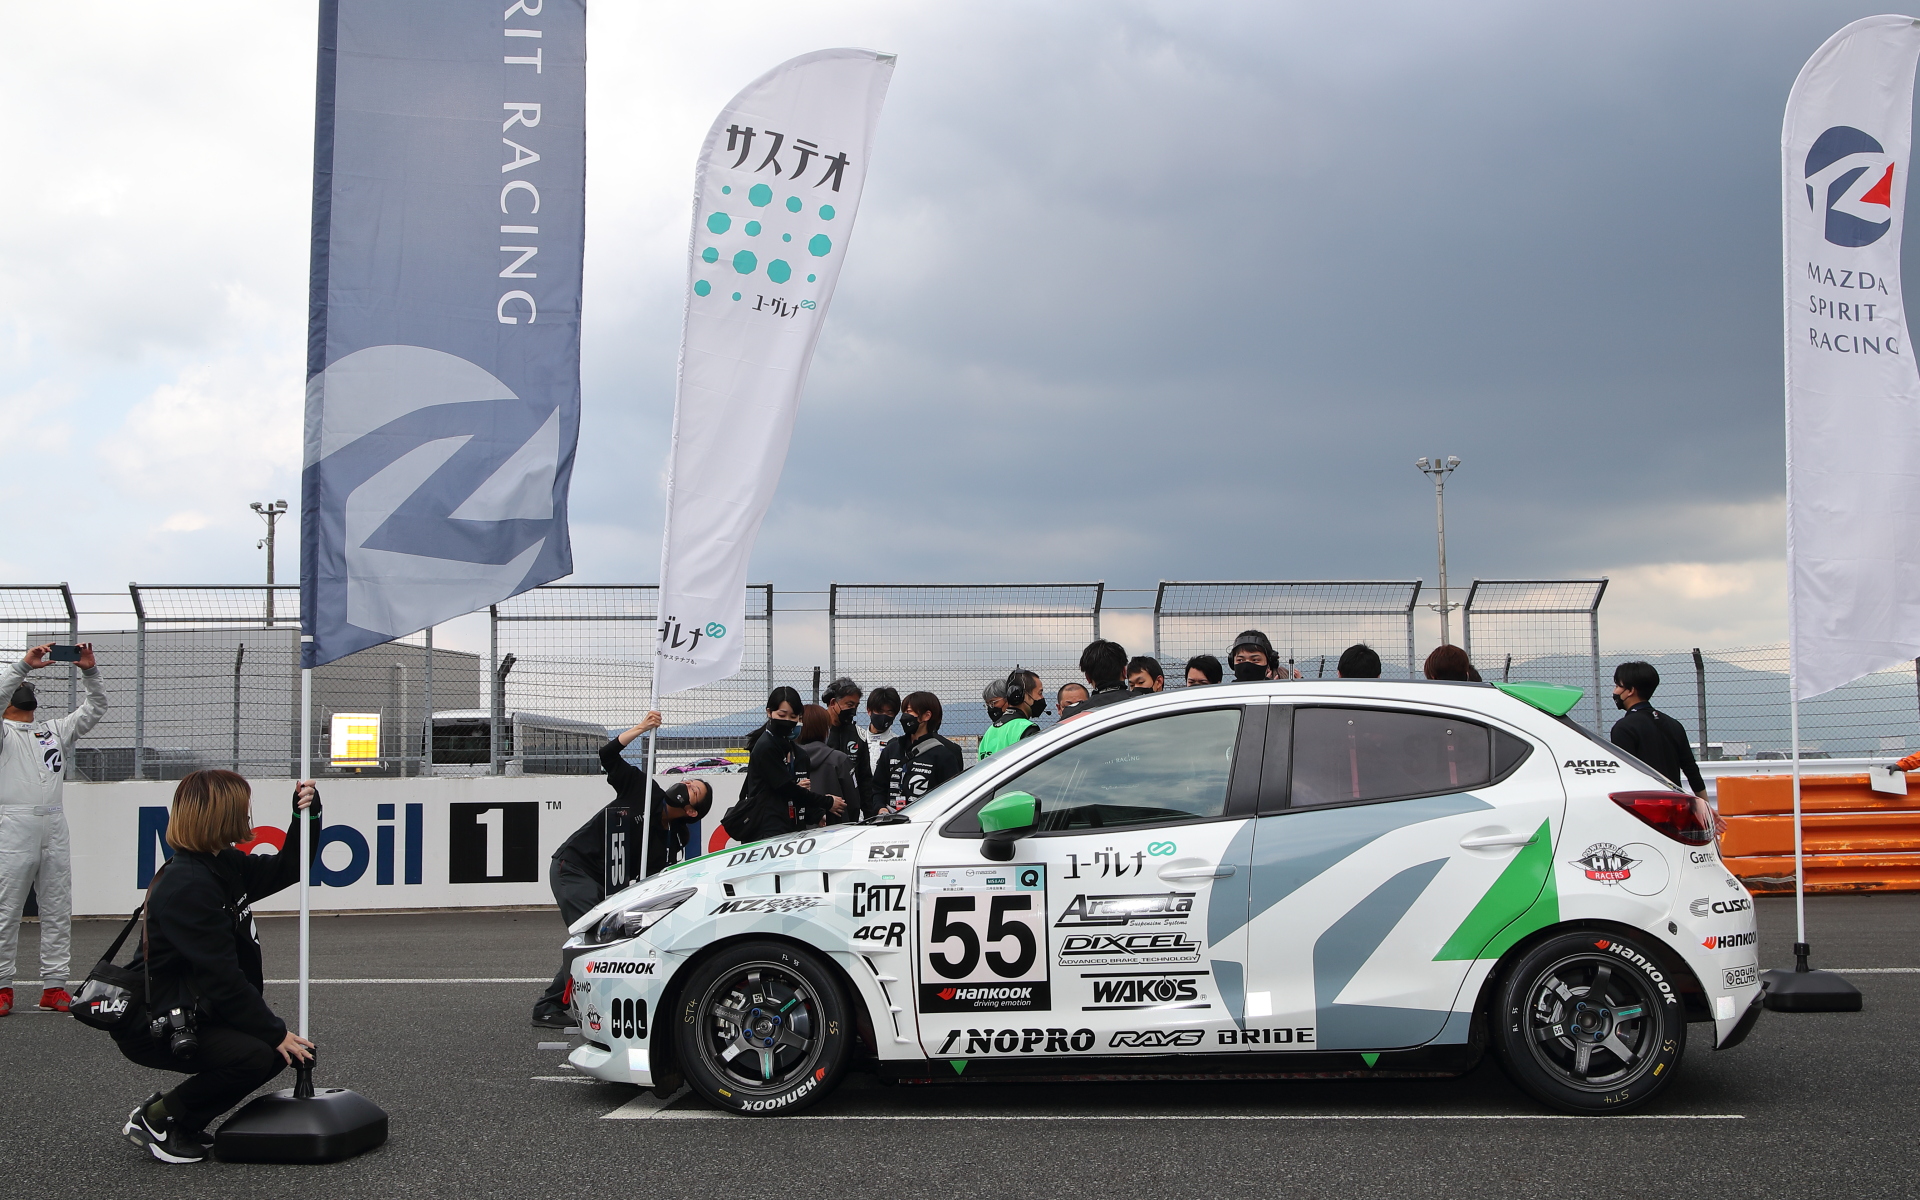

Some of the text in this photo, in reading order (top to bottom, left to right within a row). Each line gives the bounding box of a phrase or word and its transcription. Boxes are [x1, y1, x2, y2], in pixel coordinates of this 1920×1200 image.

[725, 124, 850, 192] サステオ
[497, 102, 541, 325] RACING
[1808, 262, 1888, 295] MAZDA
[752, 294, 799, 319] ユーグレナ
[1809, 295, 1877, 322] SPIRIT
[1810, 327, 1899, 354] RACING
[1564, 760, 1620, 768] AKIBA
[476, 808, 504, 878] 1
[546, 801, 562, 810] TM
[727, 838, 817, 868] DENSO
[611, 832, 626, 886] 55
[1064, 847, 1147, 879] ユーグレナ
[1021, 870, 1039, 887] Q
[1595, 872, 1624, 880] RACERS
[853, 883, 906, 917] CATZ
[853, 922, 905, 947] 4CR
[929, 895, 1036, 979] 55
[1130, 919, 1161, 928] Suspension
[1063, 934, 1197, 955] DIXCEL
[1141, 955, 1197, 963] TECHNOLOGY
[973, 999, 1032, 1008] driving emotion
[965, 1028, 1315, 1054] NOPRO RAYS BRIDE
